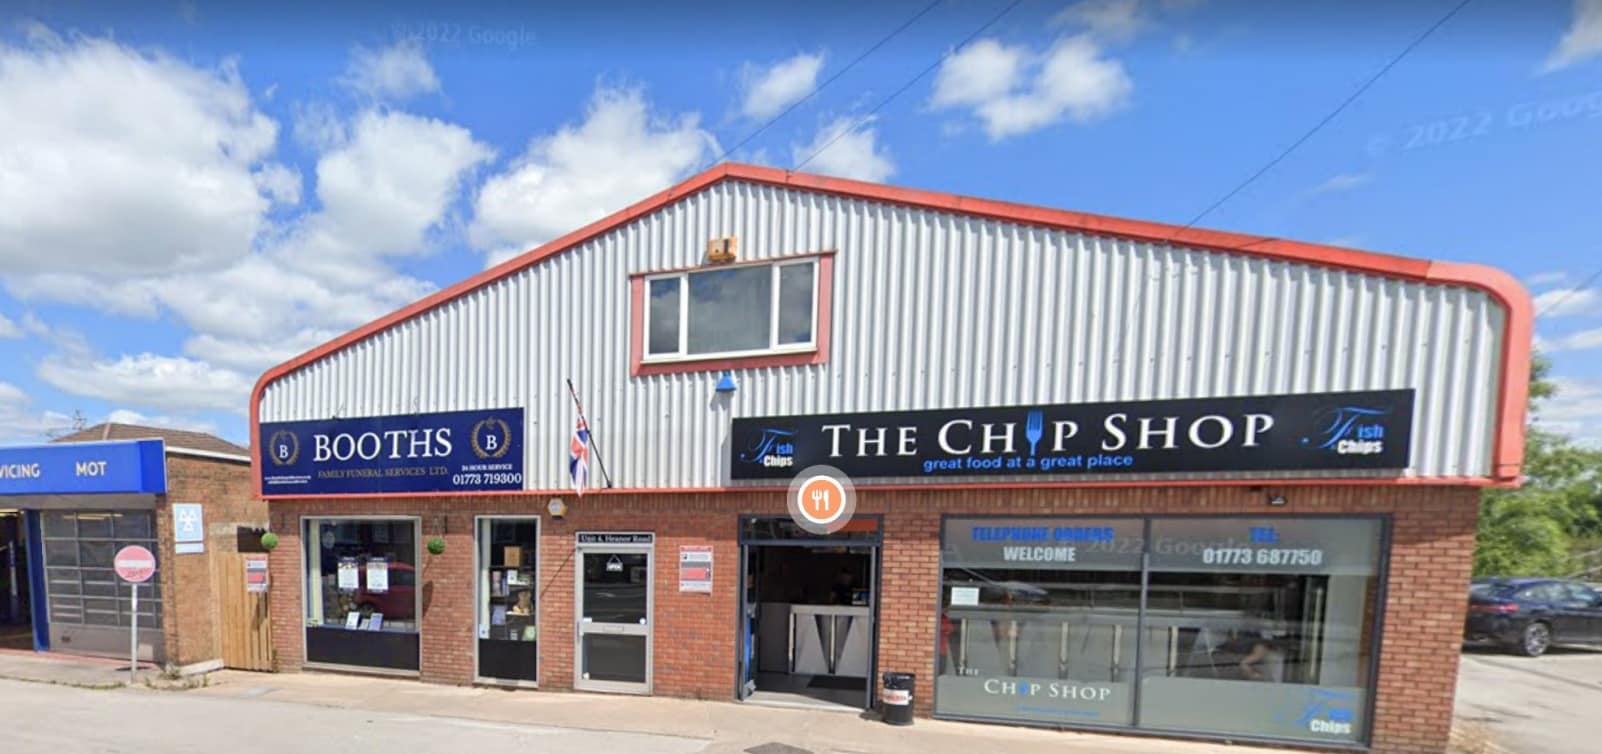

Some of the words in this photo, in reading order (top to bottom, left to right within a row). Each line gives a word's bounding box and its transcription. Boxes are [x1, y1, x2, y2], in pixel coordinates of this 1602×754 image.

[822, 424, 918, 457] THE
[1101, 412, 1275, 451] SHOP
[312, 427, 453, 462] BOOTHS
[485, 434, 498, 451] B
[1337, 440, 1383, 454] Chips
[278, 444, 289, 459] B
[76, 461, 107, 476] MOT
[763, 455, 793, 467] Chips
[923, 459, 962, 473] great
[966, 457, 1001, 469] food
[1006, 456, 1021, 468] at
[1026, 459, 1035, 468] a
[1040, 456, 1083, 470] great
[1087, 454, 1133, 469] place
[384, 467, 426, 476] SERVICES
[452, 473, 481, 485] 01773
[483, 472, 522, 485] 719300
[1054, 527, 1114, 542] ORDERS
[1003, 547, 1076, 561] WELCOME
[1203, 548, 1250, 563] 01773
[1256, 549, 1322, 565] 687750
[1050, 684, 1111, 700] SHOP
[1311, 720, 1352, 734] Chips
